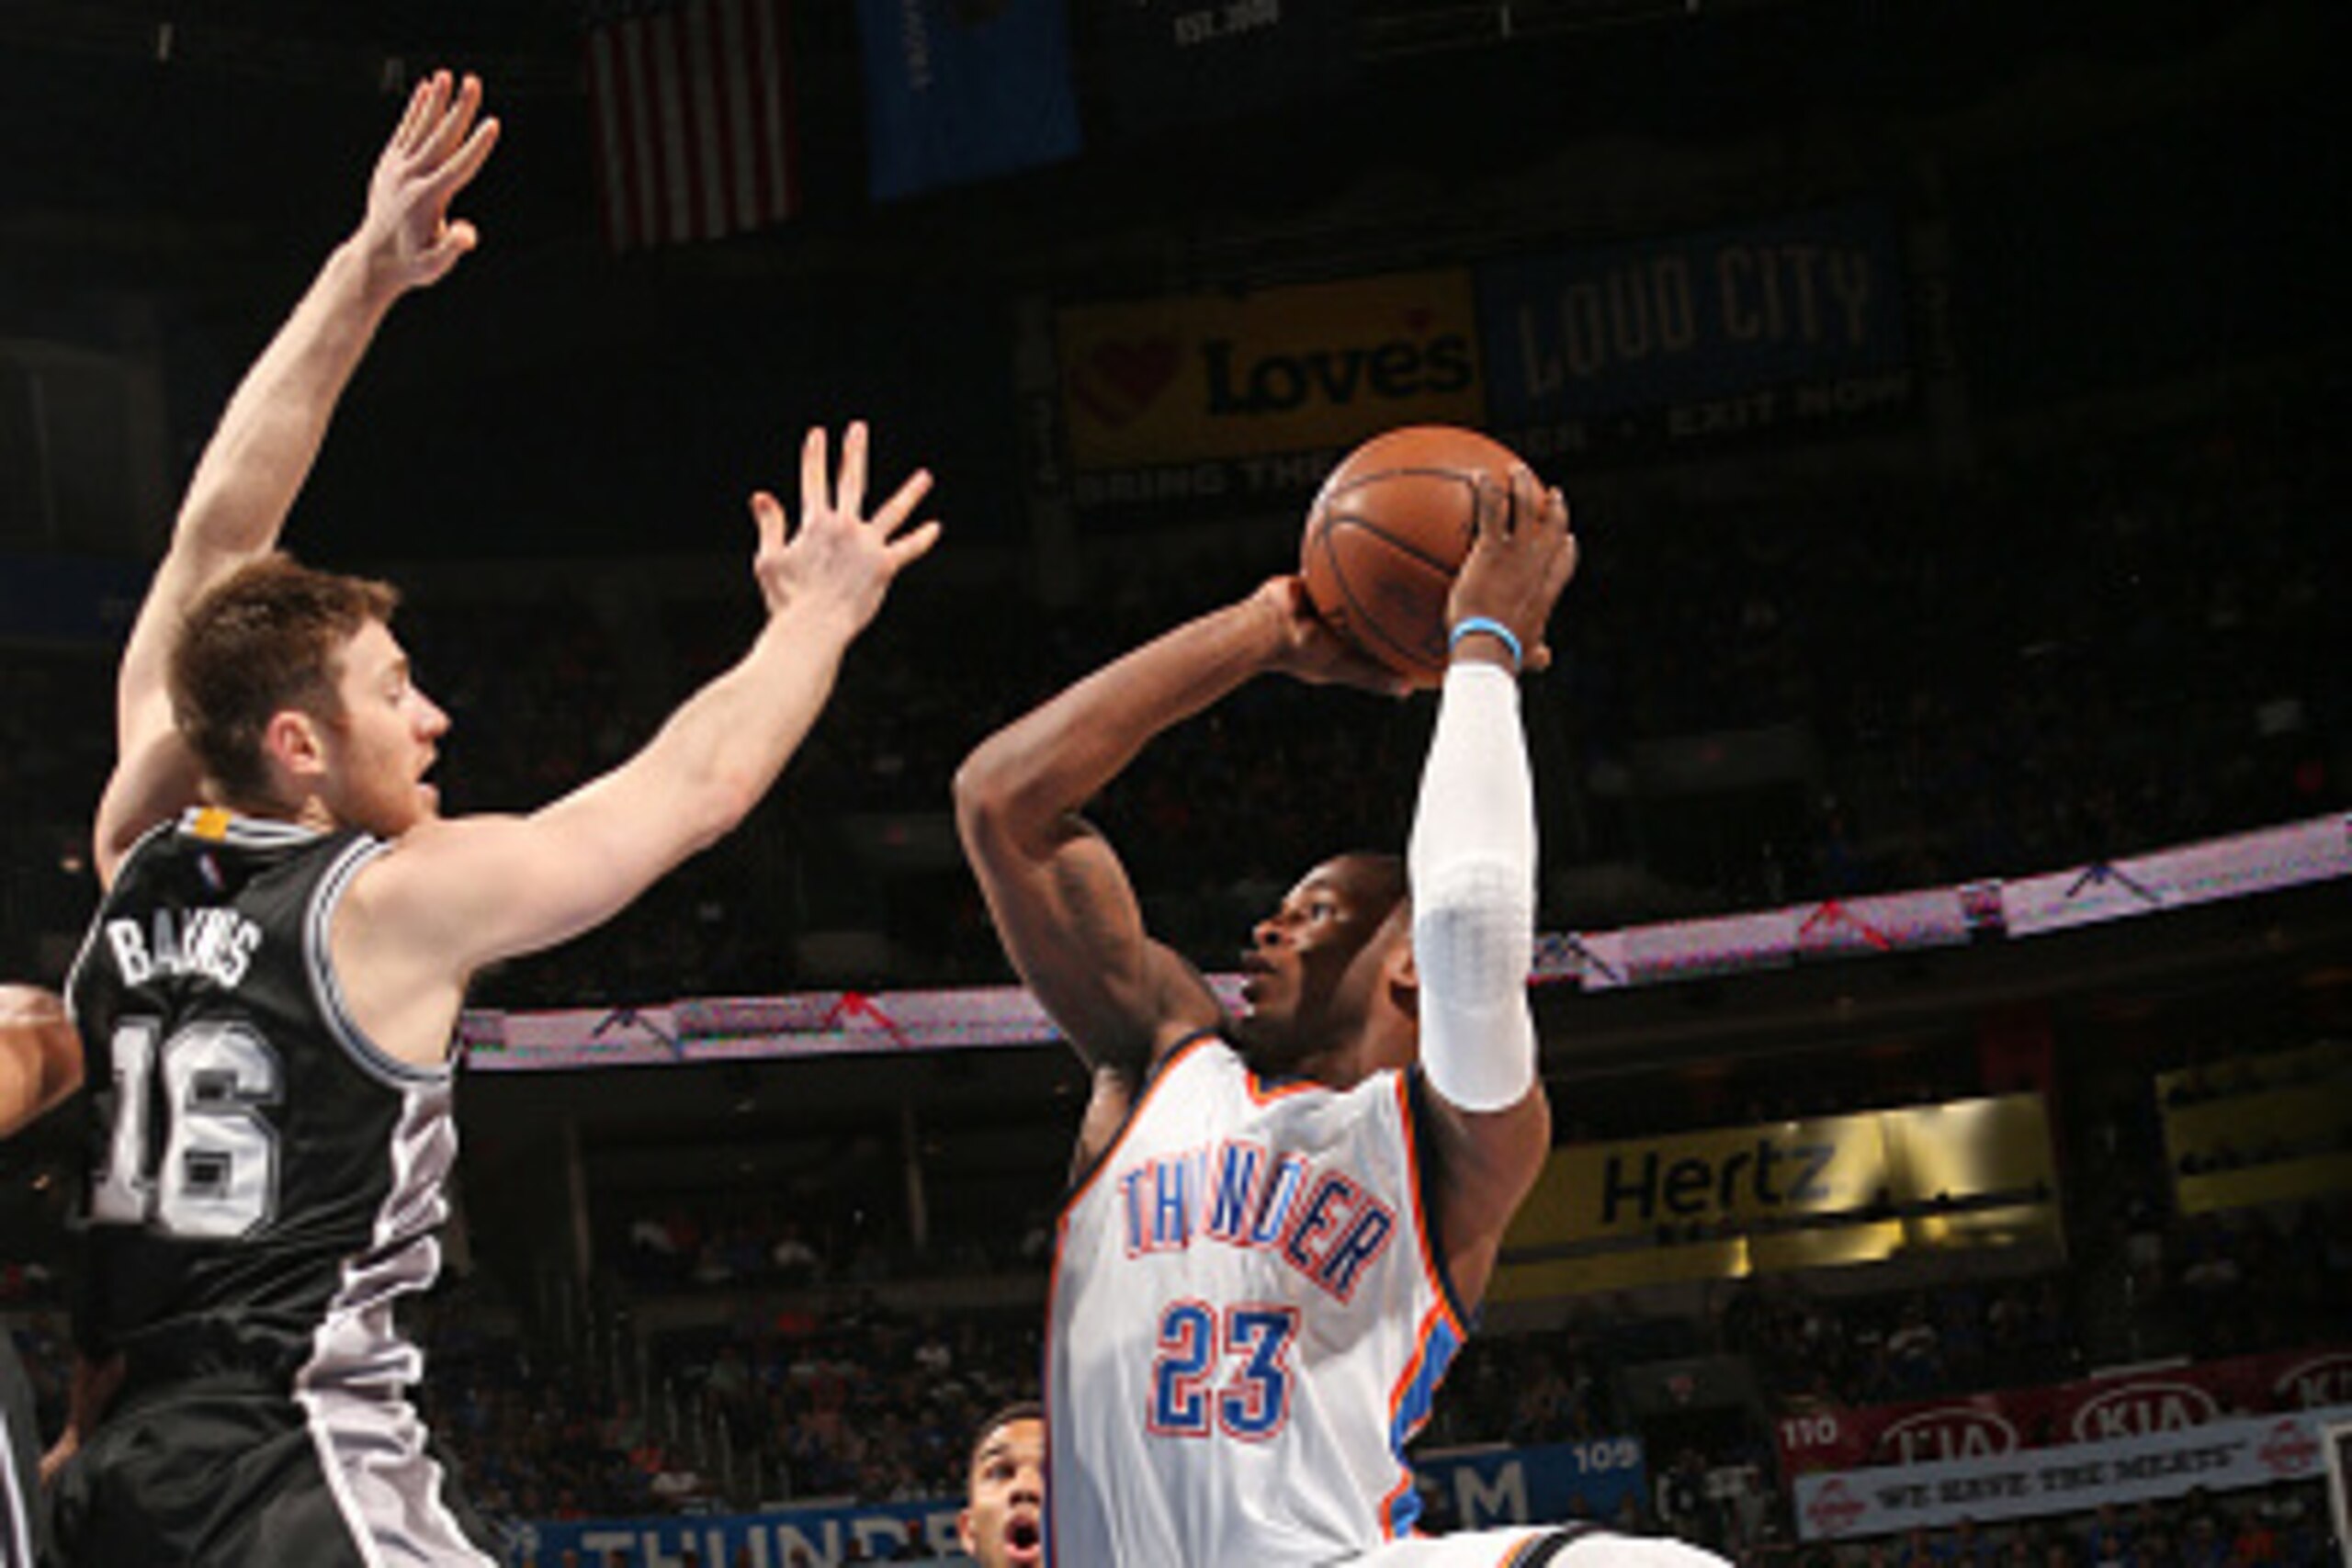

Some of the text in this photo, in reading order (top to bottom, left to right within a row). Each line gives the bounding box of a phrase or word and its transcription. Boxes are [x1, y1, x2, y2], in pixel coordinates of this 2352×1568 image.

[1518, 253, 1696, 399] LOUD
[1716, 242, 1871, 348] CITY
[1668, 391, 1776, 438] EXIT
[1074, 462, 1227, 507] BRING
[91, 1014, 279, 1238] 16
[1600, 1138, 1836, 1224] Hertz
[1147, 1294, 1302, 1444] 23
[1781, 1415, 1836, 1450] 110
[2096, 1393, 2185, 1438] KIA
[1573, 1442, 1640, 1473] 109
[1877, 1483, 1928, 1509] WE
[1939, 1472, 2030, 1504] HAVE
[2038, 1461, 2104, 1495] THE
[2114, 1447, 2234, 1481] MEATS
